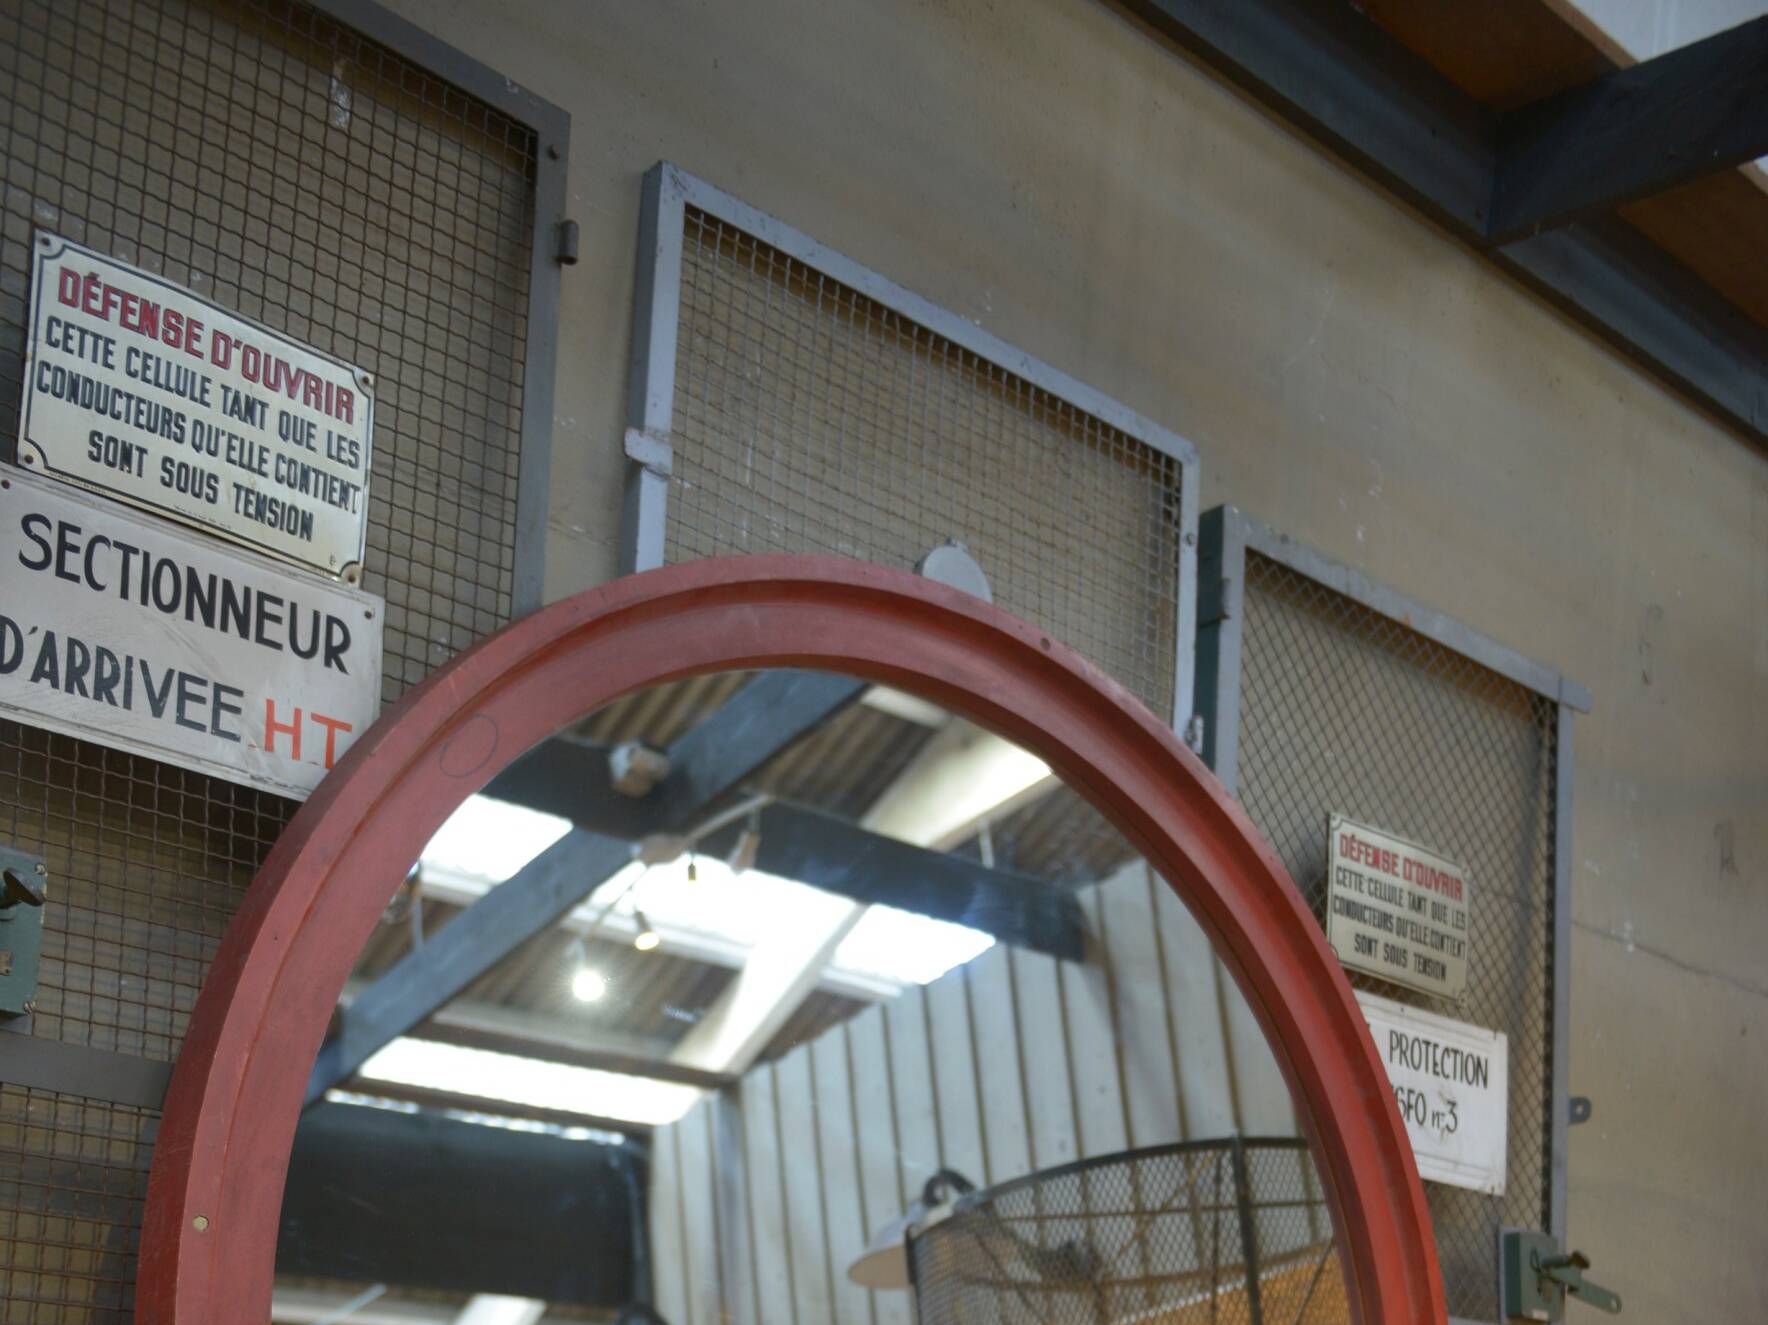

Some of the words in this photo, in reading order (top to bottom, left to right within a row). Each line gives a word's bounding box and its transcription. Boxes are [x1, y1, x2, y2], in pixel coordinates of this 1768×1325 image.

[45, 315, 116, 370] CETTE
[125, 346, 211, 408] CELLULE
[221, 384, 269, 430] TANT
[278, 410, 317, 452] QUE
[326, 430, 360, 470] LES
[58, 266, 204, 360] DÉFENSE
[211, 329, 354, 425] D'OUVRIR
[36, 360, 186, 444] CONDUCTEURS
[191, 420, 269, 478] QU'ELLE
[274, 453, 361, 515] CONTIENT
[88, 430, 148, 478] SONT
[160, 456, 219, 504] SOUS
[233, 482, 313, 542] TENSION
[18, 512, 351, 676] SECTIONNEUR
[0, 615, 244, 743] D'ARRIVEE
[264, 698, 352, 770] HT
[1333, 895, 1393, 933] CONDUCTEURS
[1430, 930, 1466, 960] CONTIENT
[1336, 866, 1365, 894] CETTE
[1367, 877, 1404, 908] CELLULE
[1407, 891, 1427, 917] TANT
[1431, 901, 1449, 925] QUE
[1451, 909, 1466, 931] LES
[1354, 933, 1379, 959] SONT
[1383, 942, 1408, 969] SOUS
[1413, 953, 1447, 982] TENSION
[1389, 1029, 1488, 1089] PROTECTION
